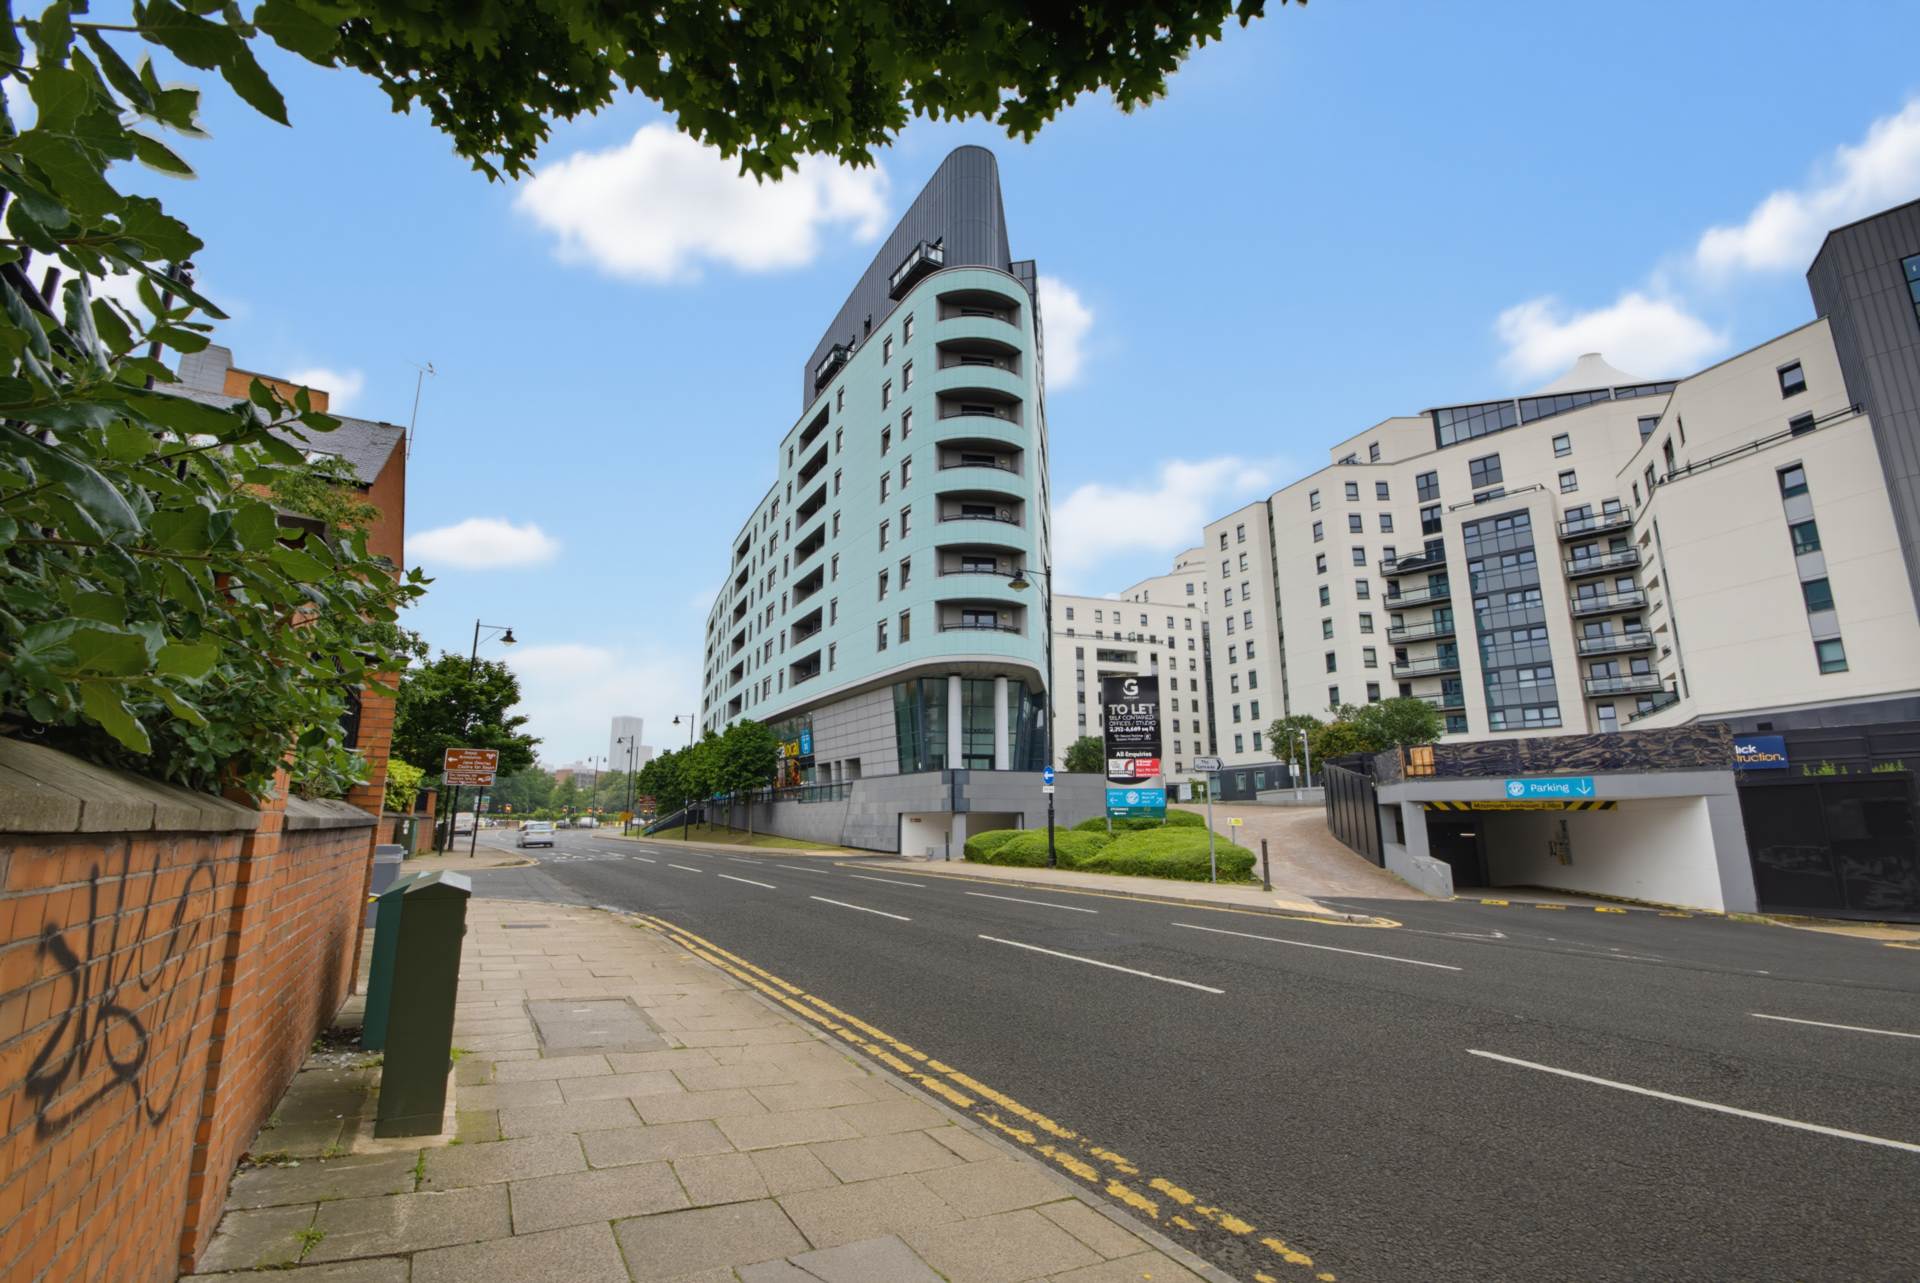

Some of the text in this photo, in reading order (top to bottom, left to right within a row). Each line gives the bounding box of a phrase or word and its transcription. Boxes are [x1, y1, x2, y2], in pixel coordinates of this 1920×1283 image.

[1108, 703, 1156, 715] TO LET
[1530, 783, 1570, 794] Parking
